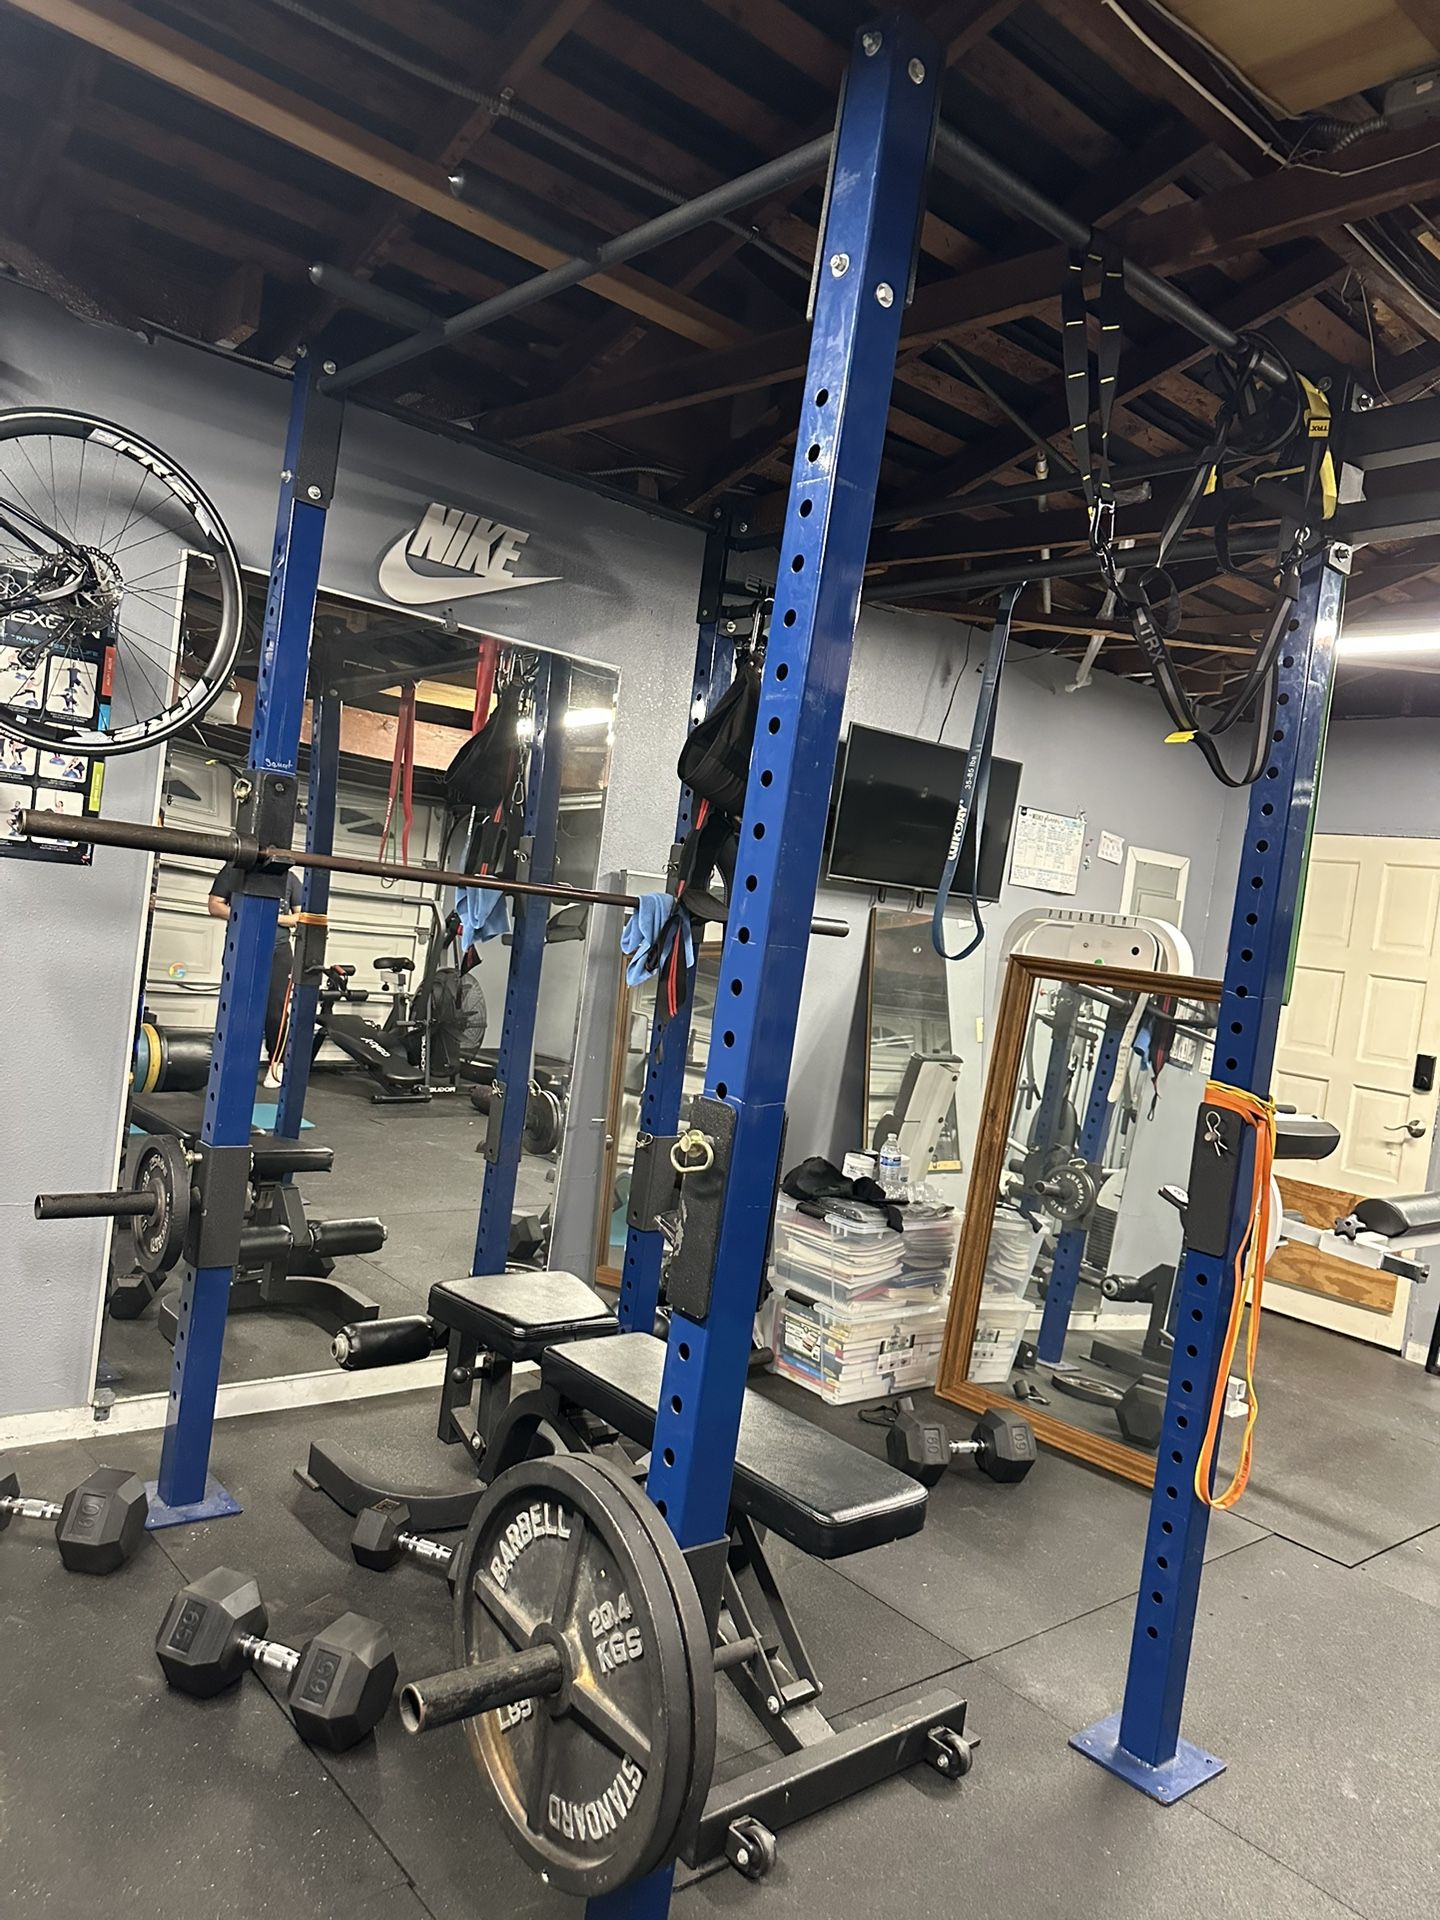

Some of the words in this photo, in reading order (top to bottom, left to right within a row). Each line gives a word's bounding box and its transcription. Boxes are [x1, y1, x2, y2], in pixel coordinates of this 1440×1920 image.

[408, 502, 530, 578] NIKE
[1140, 623, 1166, 664] TRX
[490, 1502, 571, 1589] BARBELL
[176, 1611, 200, 1642] 65
[588, 1592, 633, 1639] 20.4
[595, 1626, 643, 1673] KGS
[310, 1660, 334, 1694] 65
[548, 1753, 643, 1841] STANDARD
